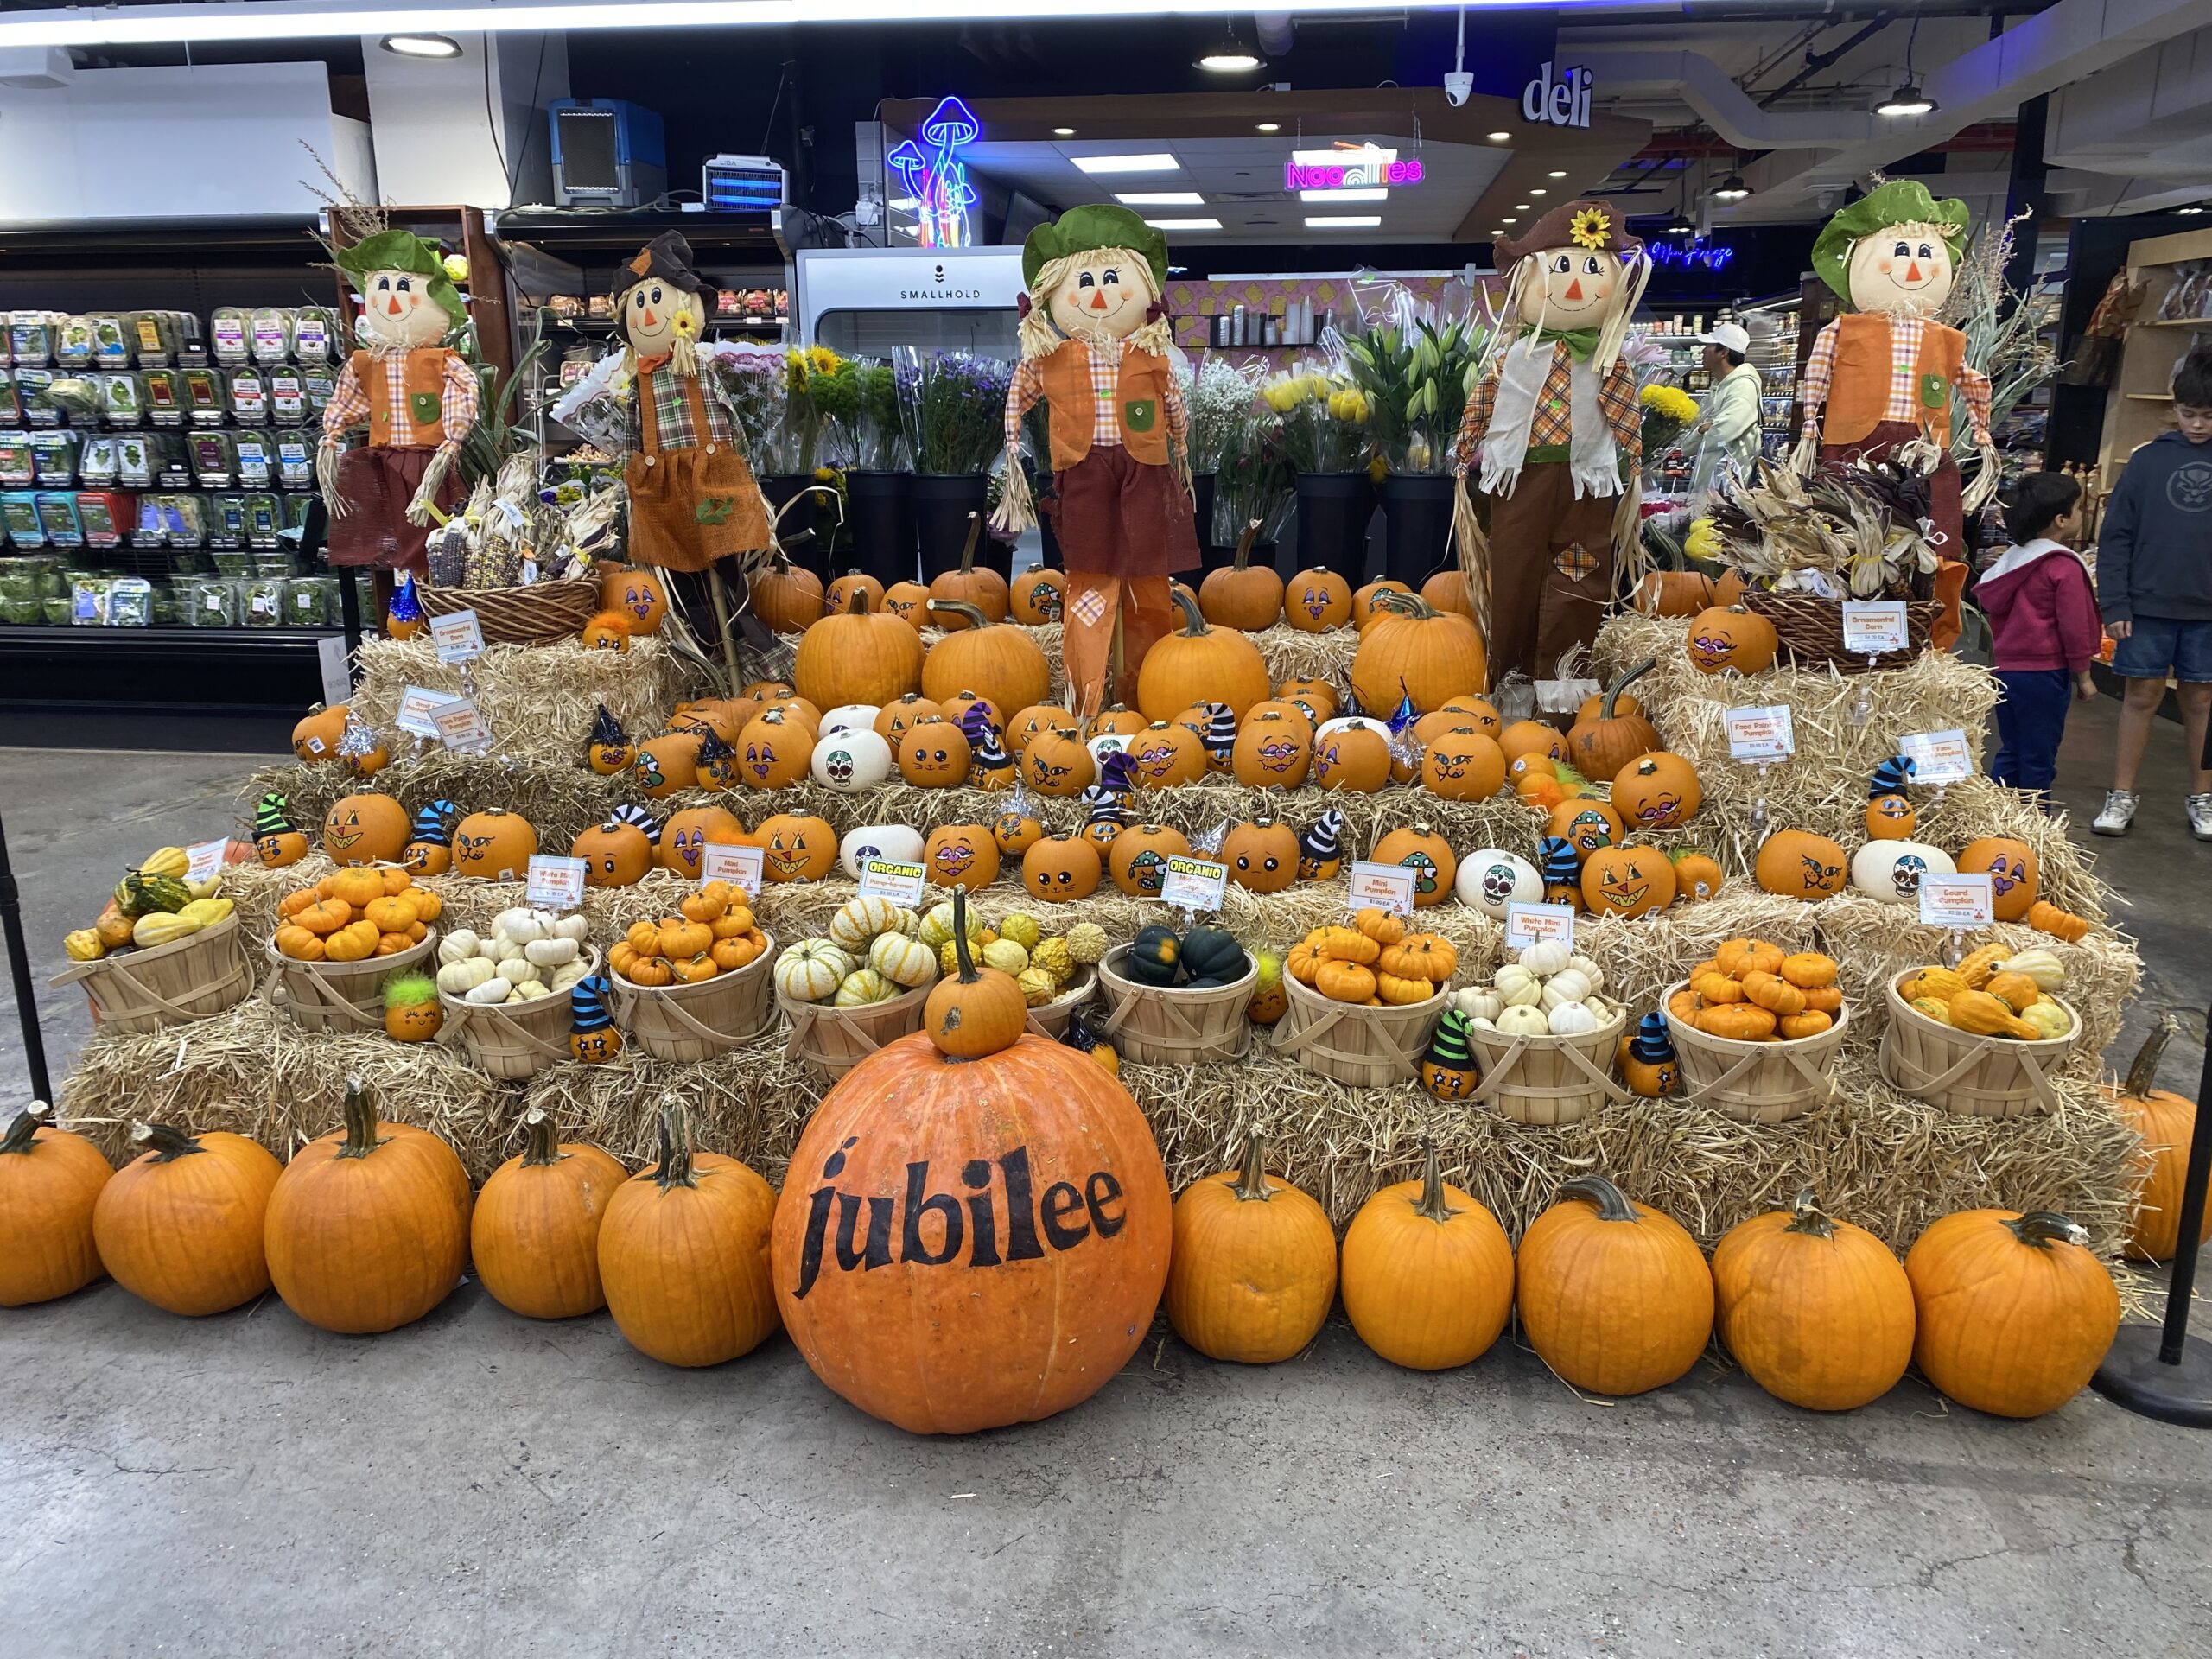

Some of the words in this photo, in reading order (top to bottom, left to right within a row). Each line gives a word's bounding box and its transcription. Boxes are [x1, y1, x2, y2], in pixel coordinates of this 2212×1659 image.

[1523, 61, 1592, 127] deli
[1286, 154, 1424, 188] Noodles
[900, 290, 980, 299] SMALLHOLD
[439, 625, 470, 636] Ornamental
[453, 712, 474, 721] Painted
[448, 721, 472, 730] Pumpkin
[718, 866, 747, 875] Pumpkin
[868, 861, 923, 878] ORGANIC
[1169, 860, 1222, 880] ORGANIC
[1365, 886, 1396, 895] Pumpkin
[1939, 897, 1974, 906] Pumpkin
[1523, 925, 1556, 933] Pumpkin
[792, 1135, 1127, 1300] jubilee
